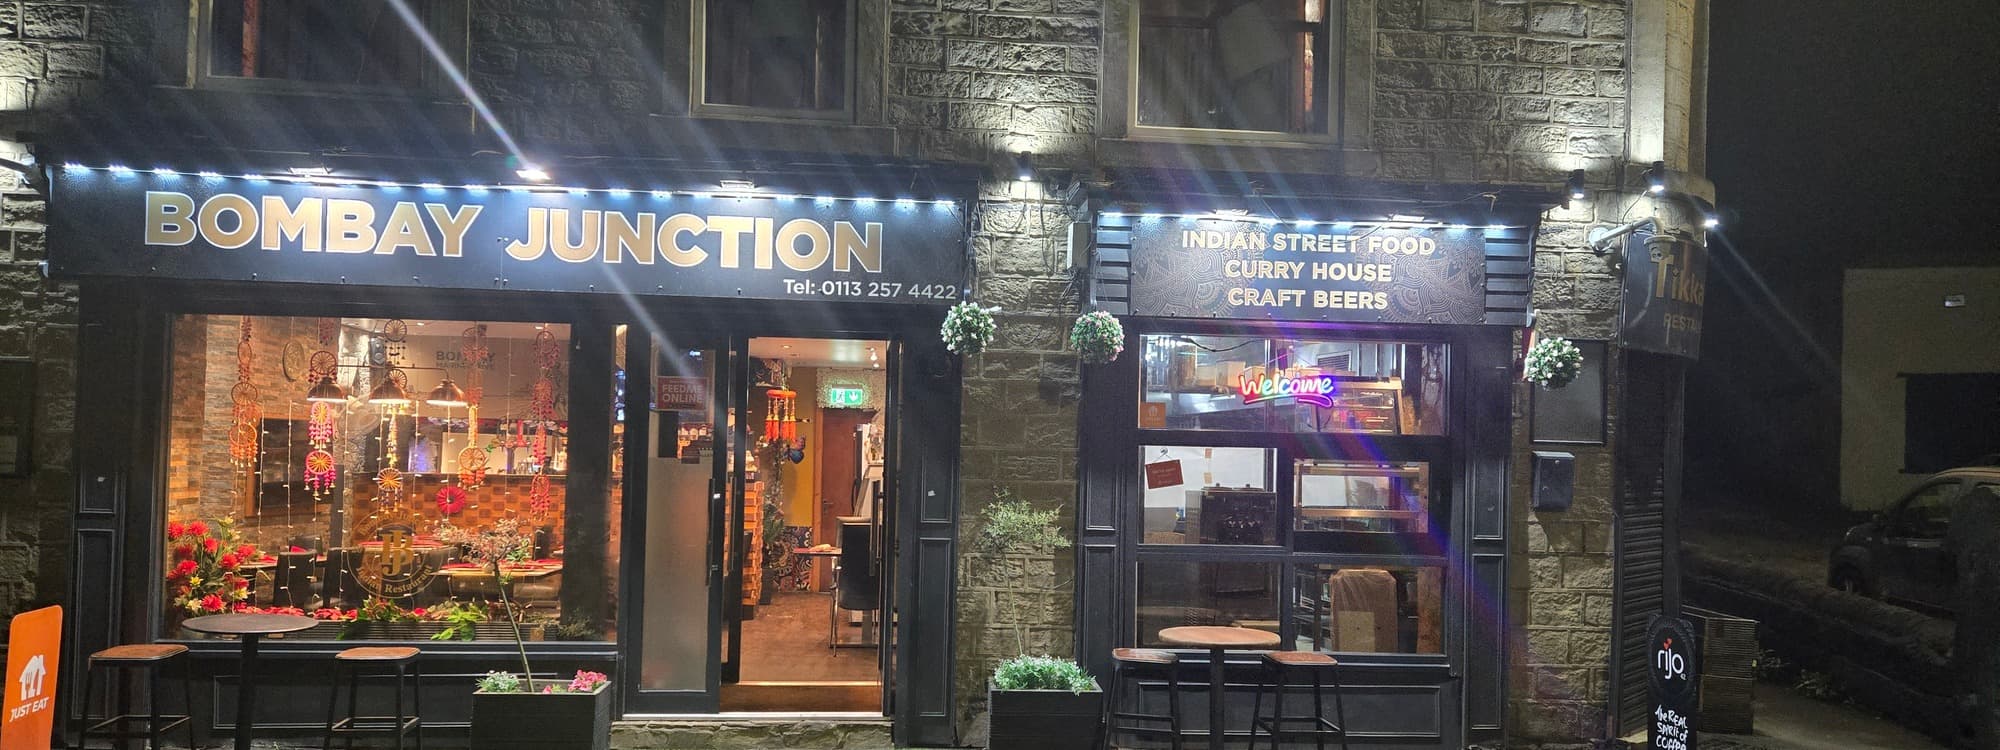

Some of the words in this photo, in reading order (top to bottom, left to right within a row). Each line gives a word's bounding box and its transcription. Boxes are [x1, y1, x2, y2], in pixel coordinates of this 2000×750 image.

[145, 191, 484, 257] BOMBAY
[505, 207, 883, 273] JUNCTION
[1182, 230, 1265, 250] INDIAN
[1273, 233, 1359, 253] STREET
[1368, 236, 1436, 255] FOOD
[1224, 260, 1304, 279] CURRY
[1312, 262, 1392, 282] HOUSE
[783, 279, 816, 295] Tel:
[821, 280, 862, 296] 0113
[868, 283, 902, 297] 257
[908, 284, 956, 300] 4422
[1228, 288, 1306, 307] CRAFT
[1313, 290, 1388, 310] BEERS
[1239, 373, 1334, 396] Welcome
[662, 393, 704, 404] ONLINE
[385, 564, 433, 593] Restaurant
[1658, 642, 1685, 680] rijo
[9, 703, 32, 722] JUST
[32, 696, 49, 713] EAT
[1667, 709, 1688, 729] REAL
[1679, 729, 1689, 744] of
